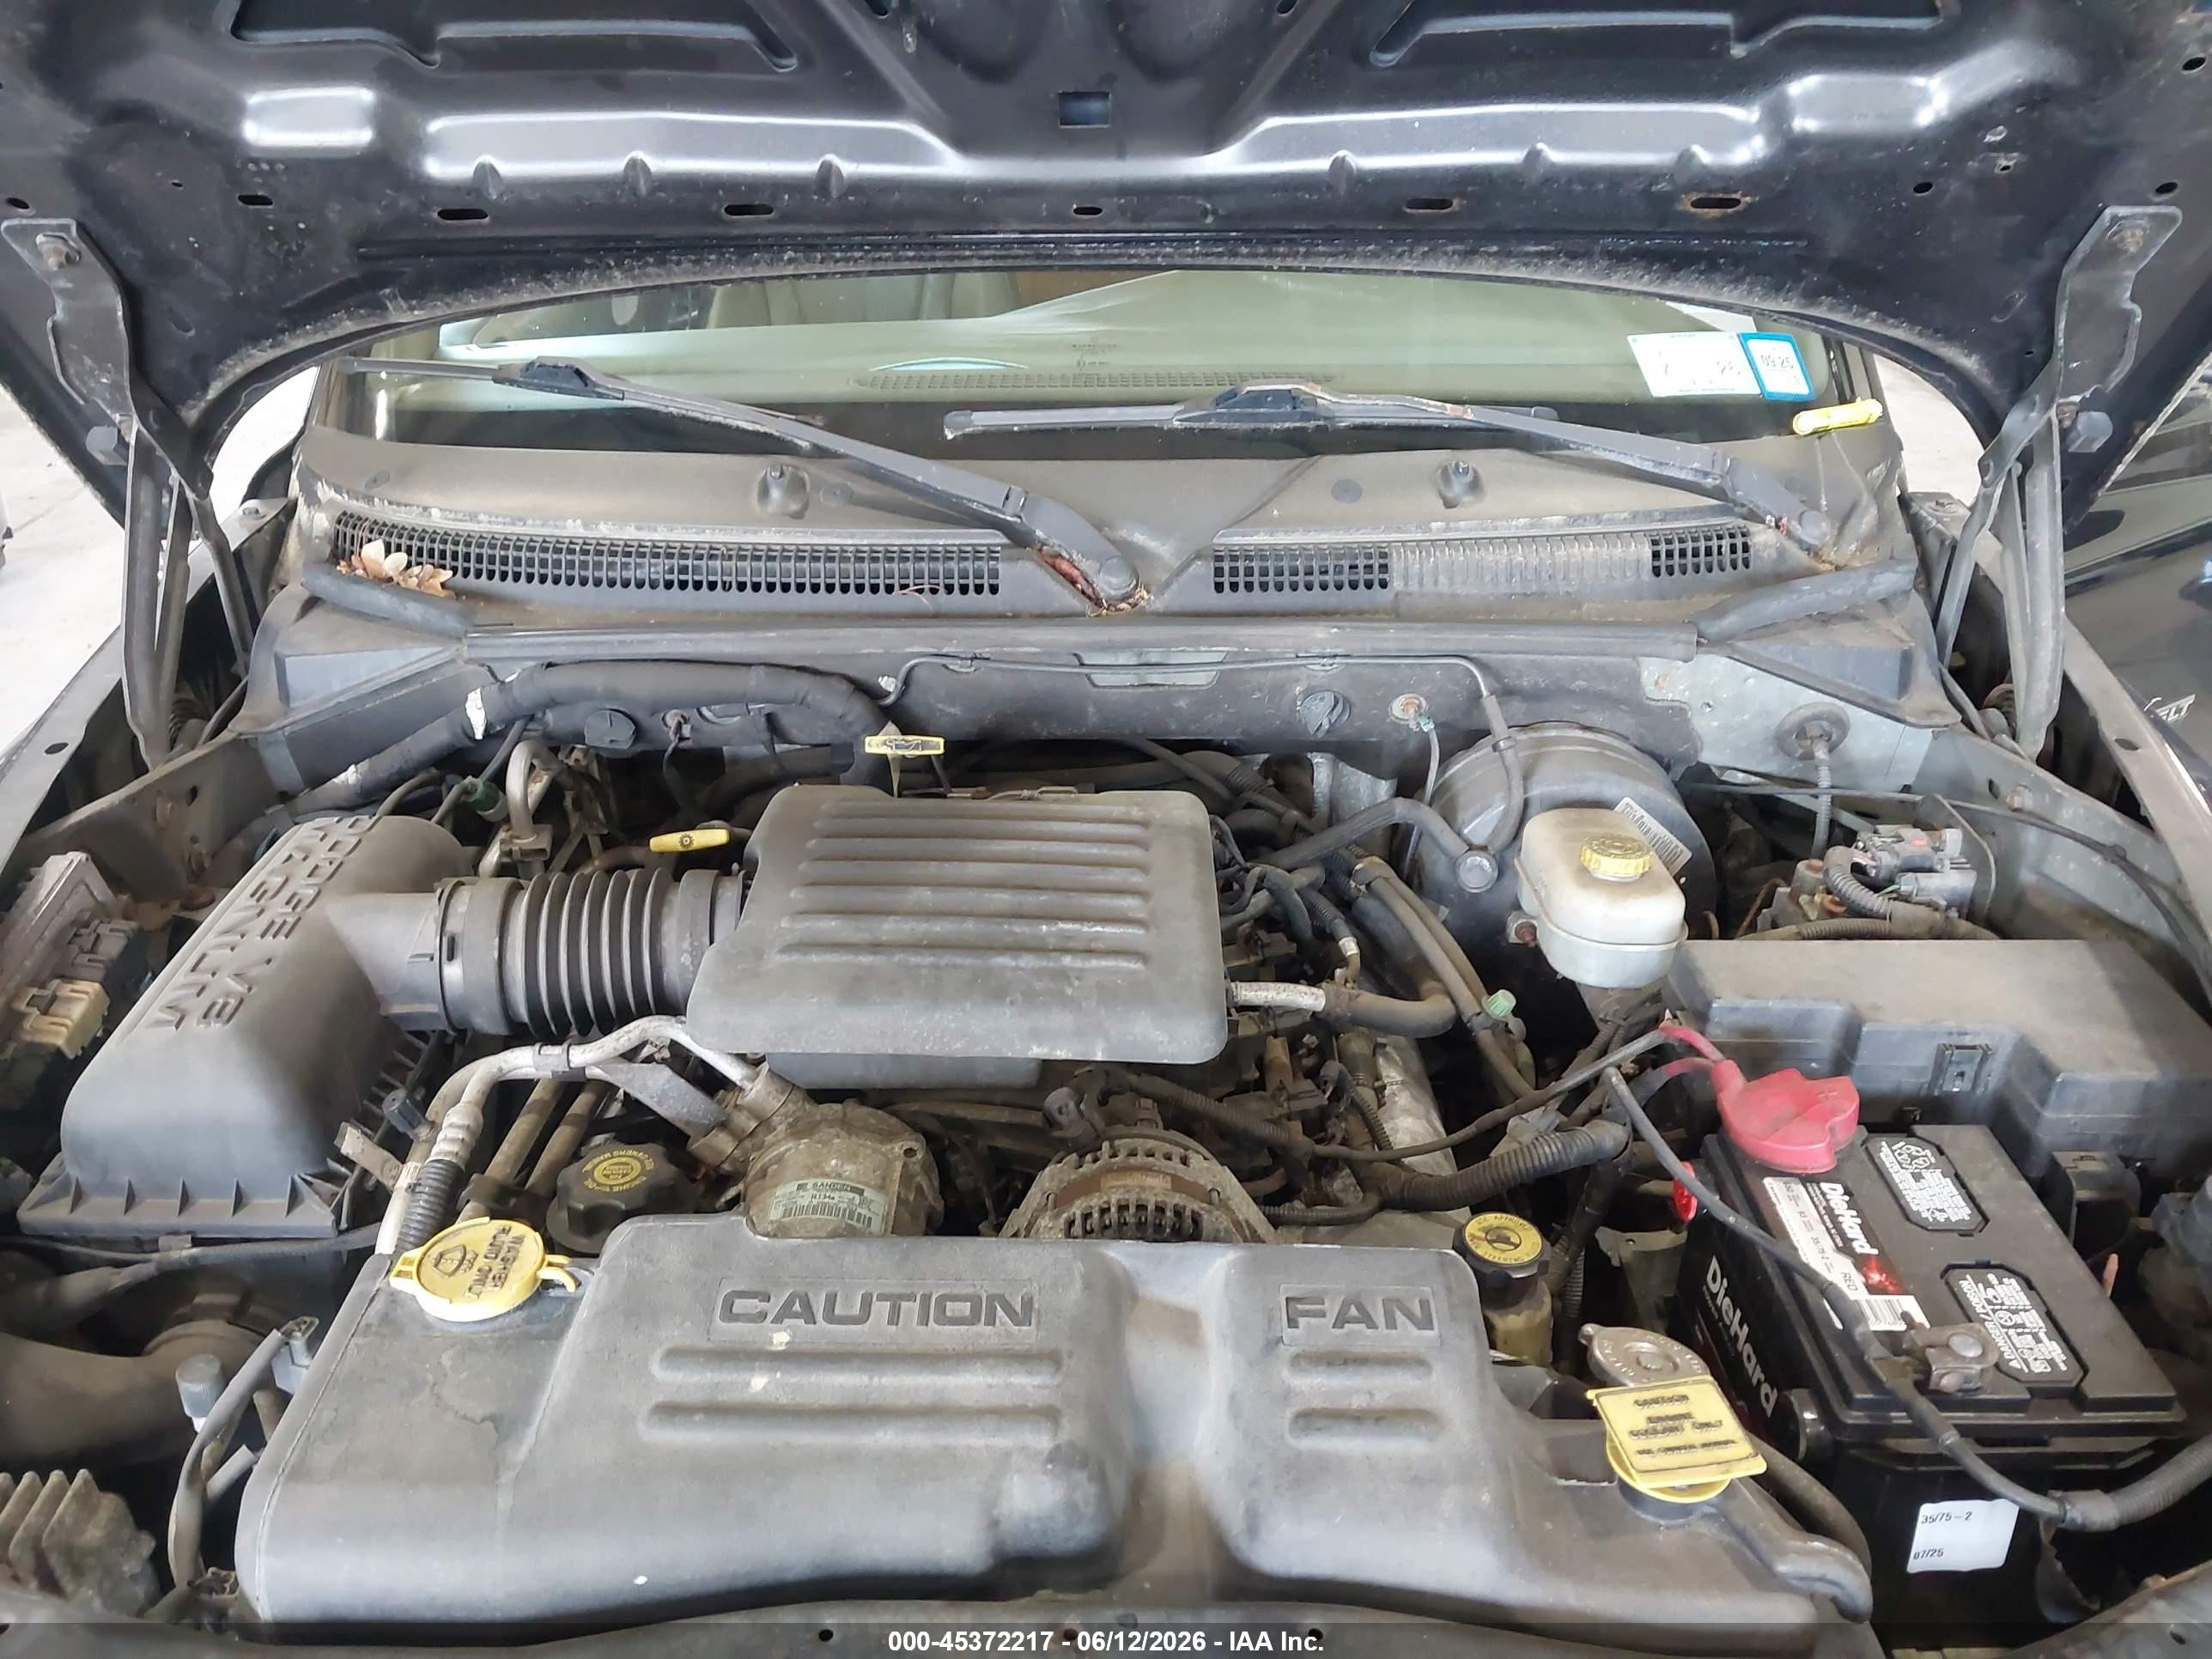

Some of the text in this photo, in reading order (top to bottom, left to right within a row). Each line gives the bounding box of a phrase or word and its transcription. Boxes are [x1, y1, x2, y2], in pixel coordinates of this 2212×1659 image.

[257, 815, 383, 941] DODGE
[1820, 1182, 1879, 1255] DieHard
[717, 1290, 1437, 1333] CAUTION FAN
[1959, 1279, 1987, 1314] POISON
[1706, 1255, 1778, 1419] DieHard
[1984, 1321, 2016, 1359] DANGER
[1921, 1511, 1953, 1525] 35/75
[1964, 1510, 1973, 1522] 2
[1913, 1547, 1944, 1560] 07/25
